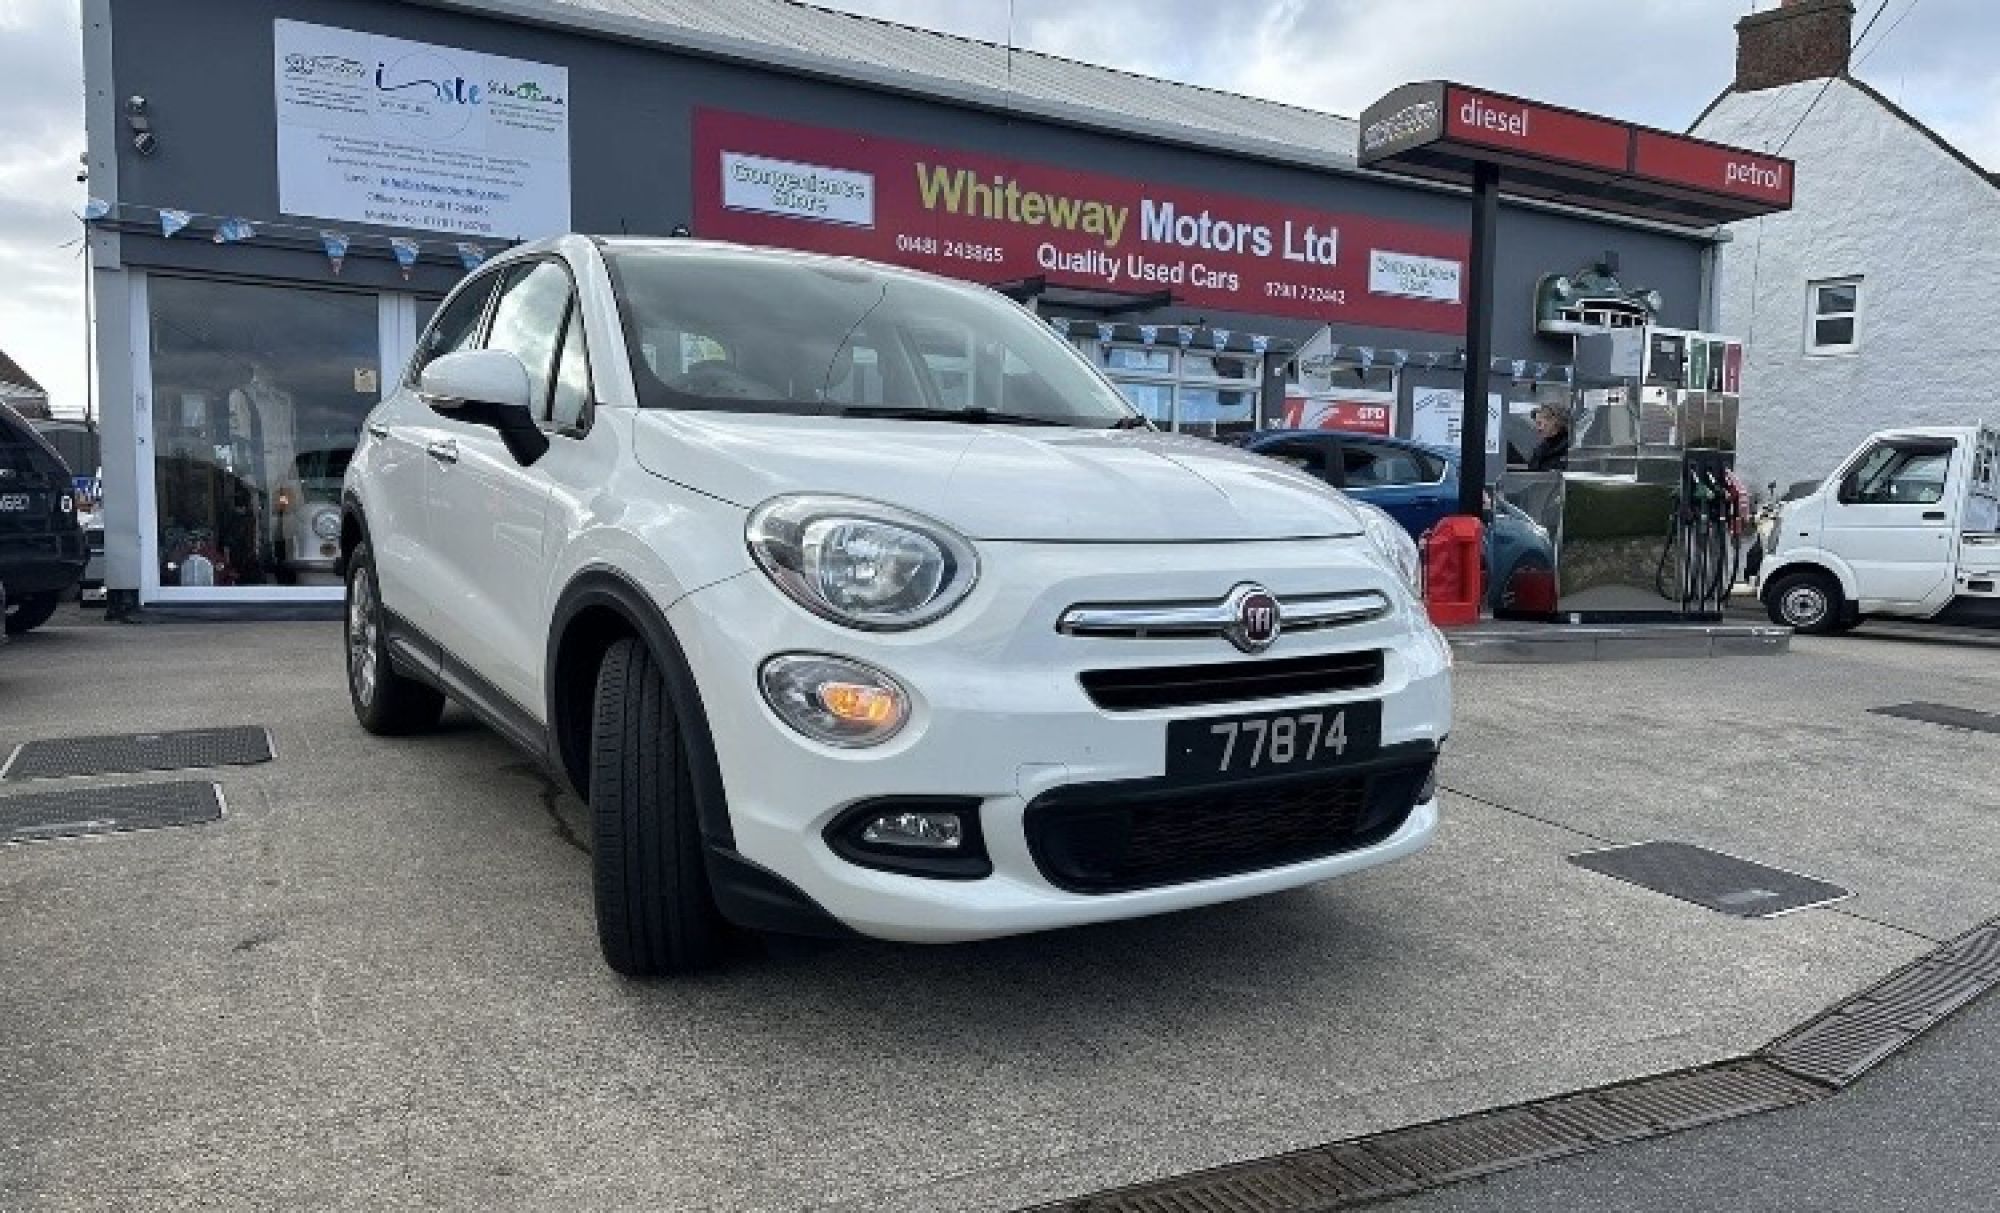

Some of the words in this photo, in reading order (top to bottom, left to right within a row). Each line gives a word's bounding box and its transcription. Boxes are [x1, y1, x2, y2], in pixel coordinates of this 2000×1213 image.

[1459, 98, 1528, 137] diesel
[1725, 161, 1783, 190] petrol
[916, 162, 1129, 247] Whiteway
[1141, 199, 1273, 257] Motors
[1282, 220, 1338, 266] Ltd
[896, 234, 938, 255] 01481
[1036, 243, 1121, 283] Quality
[1128, 253, 1185, 285] Used
[1191, 263, 1240, 291] Cars
[1210, 711, 1348, 772] 77874
